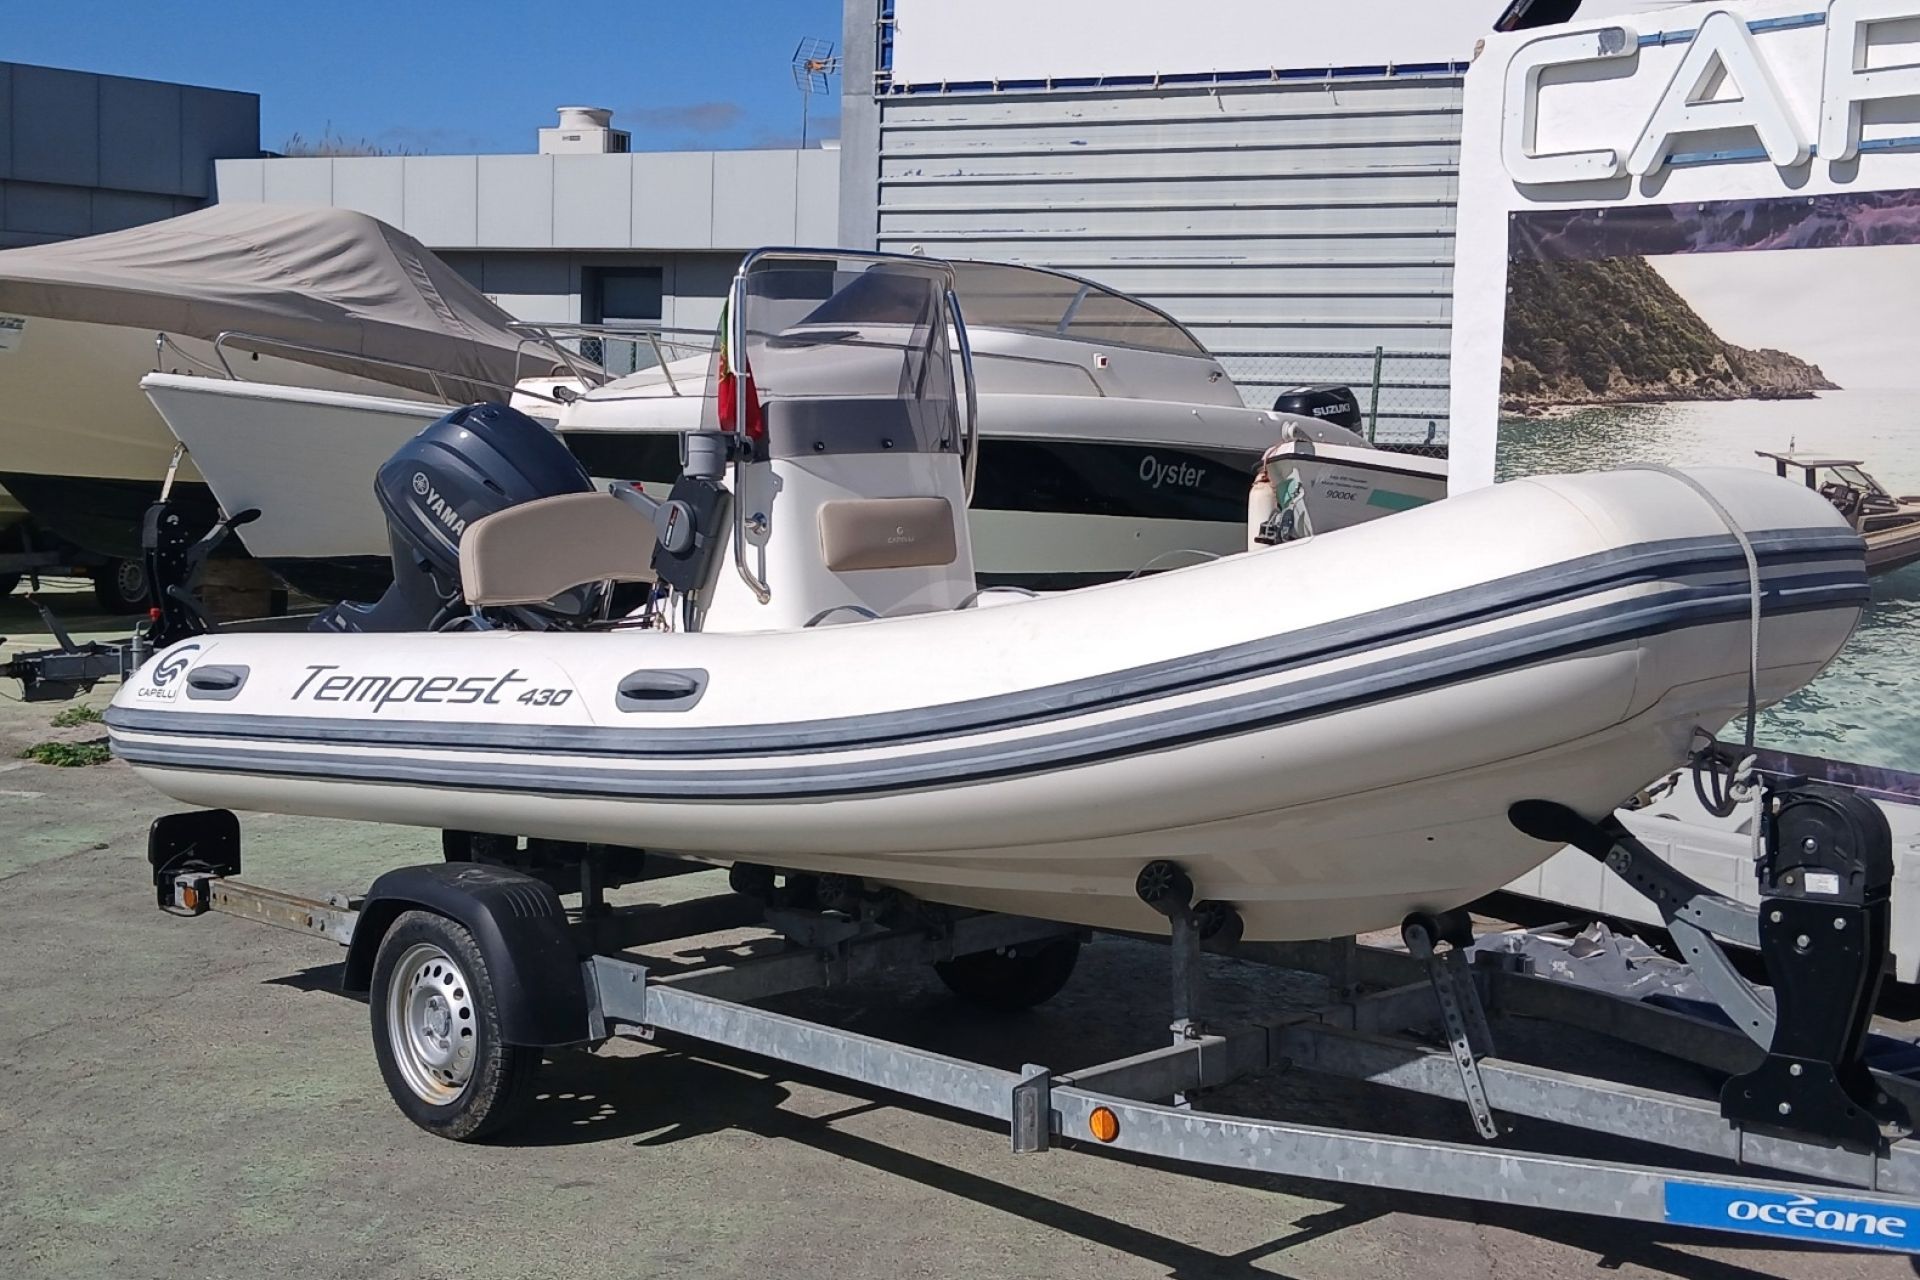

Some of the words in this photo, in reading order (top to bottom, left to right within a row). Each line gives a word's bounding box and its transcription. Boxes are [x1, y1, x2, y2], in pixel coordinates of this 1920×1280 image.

[1313, 403, 1350, 416] SUZUKI
[1140, 455, 1206, 489] Oyster
[426, 487, 466, 537] YAMA
[138, 687, 176, 698] CAPELLI
[291, 665, 528, 714] Tempest
[516, 688, 573, 707] 430
